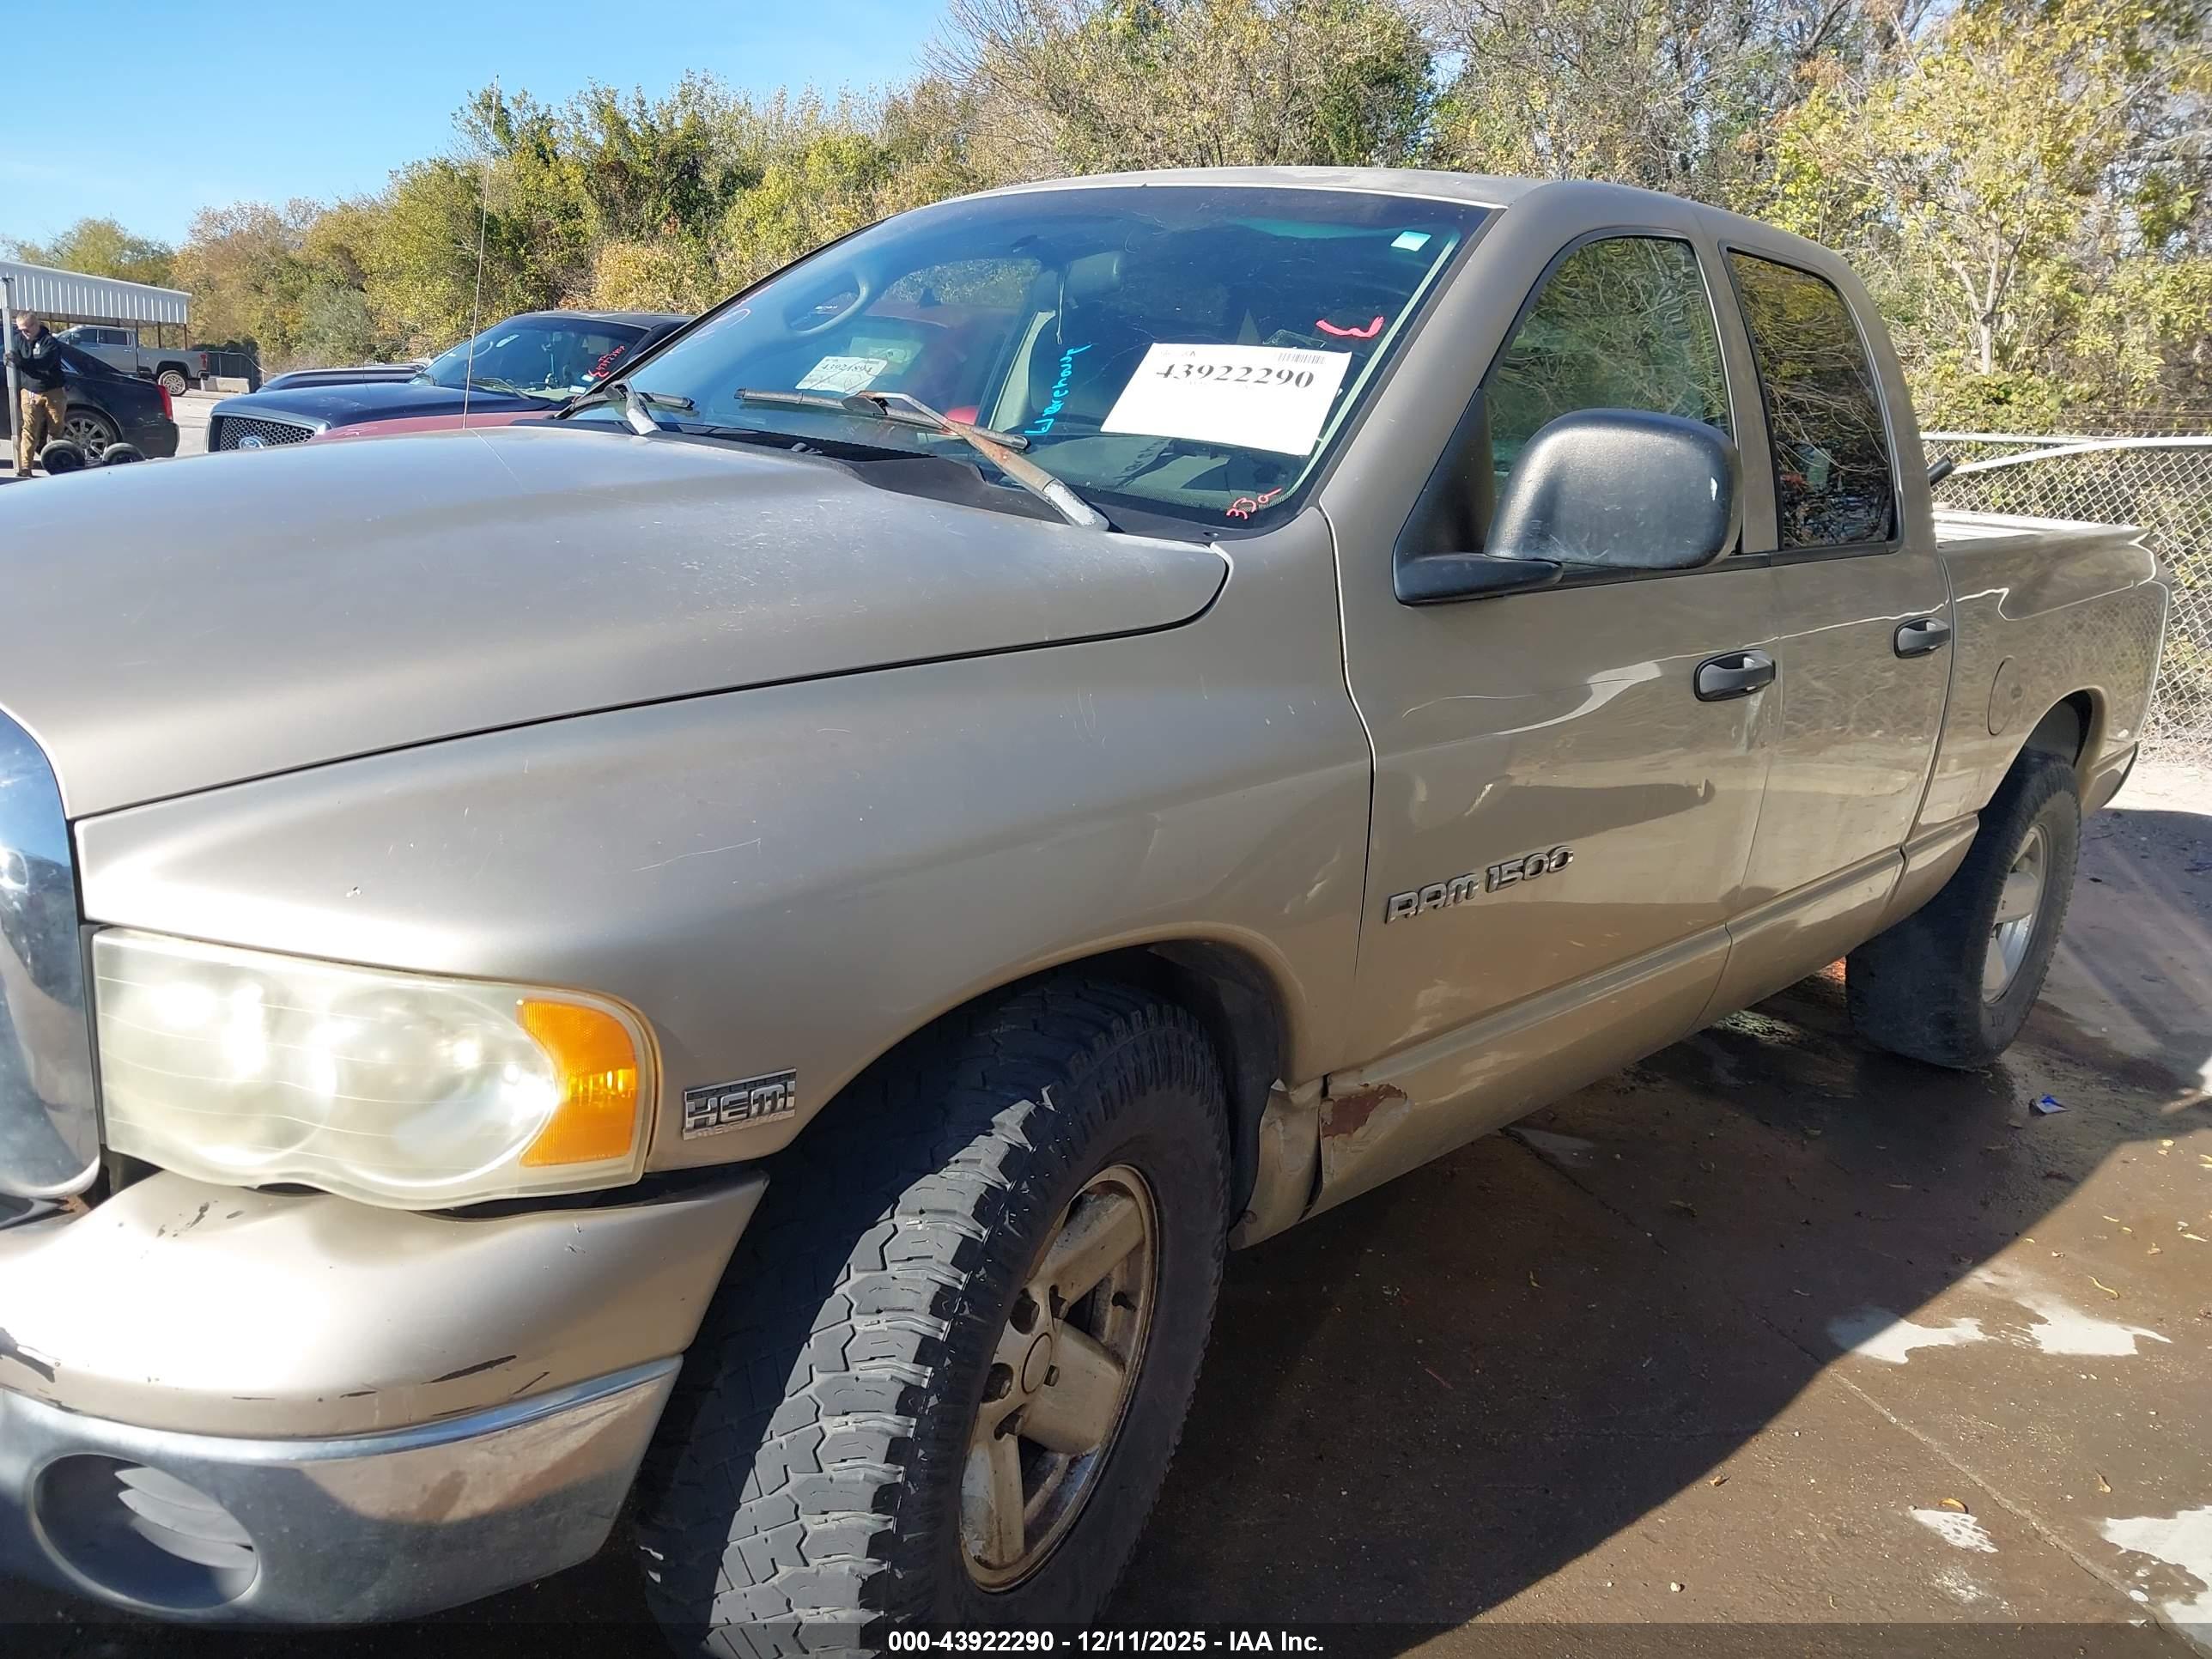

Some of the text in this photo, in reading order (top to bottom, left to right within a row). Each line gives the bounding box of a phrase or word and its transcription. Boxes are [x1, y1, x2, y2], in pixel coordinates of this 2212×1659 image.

[1156, 359, 1315, 389] 43922290
[1384, 845, 1574, 924] RAM 1500
[687, 1080, 796, 1131] HEMI
